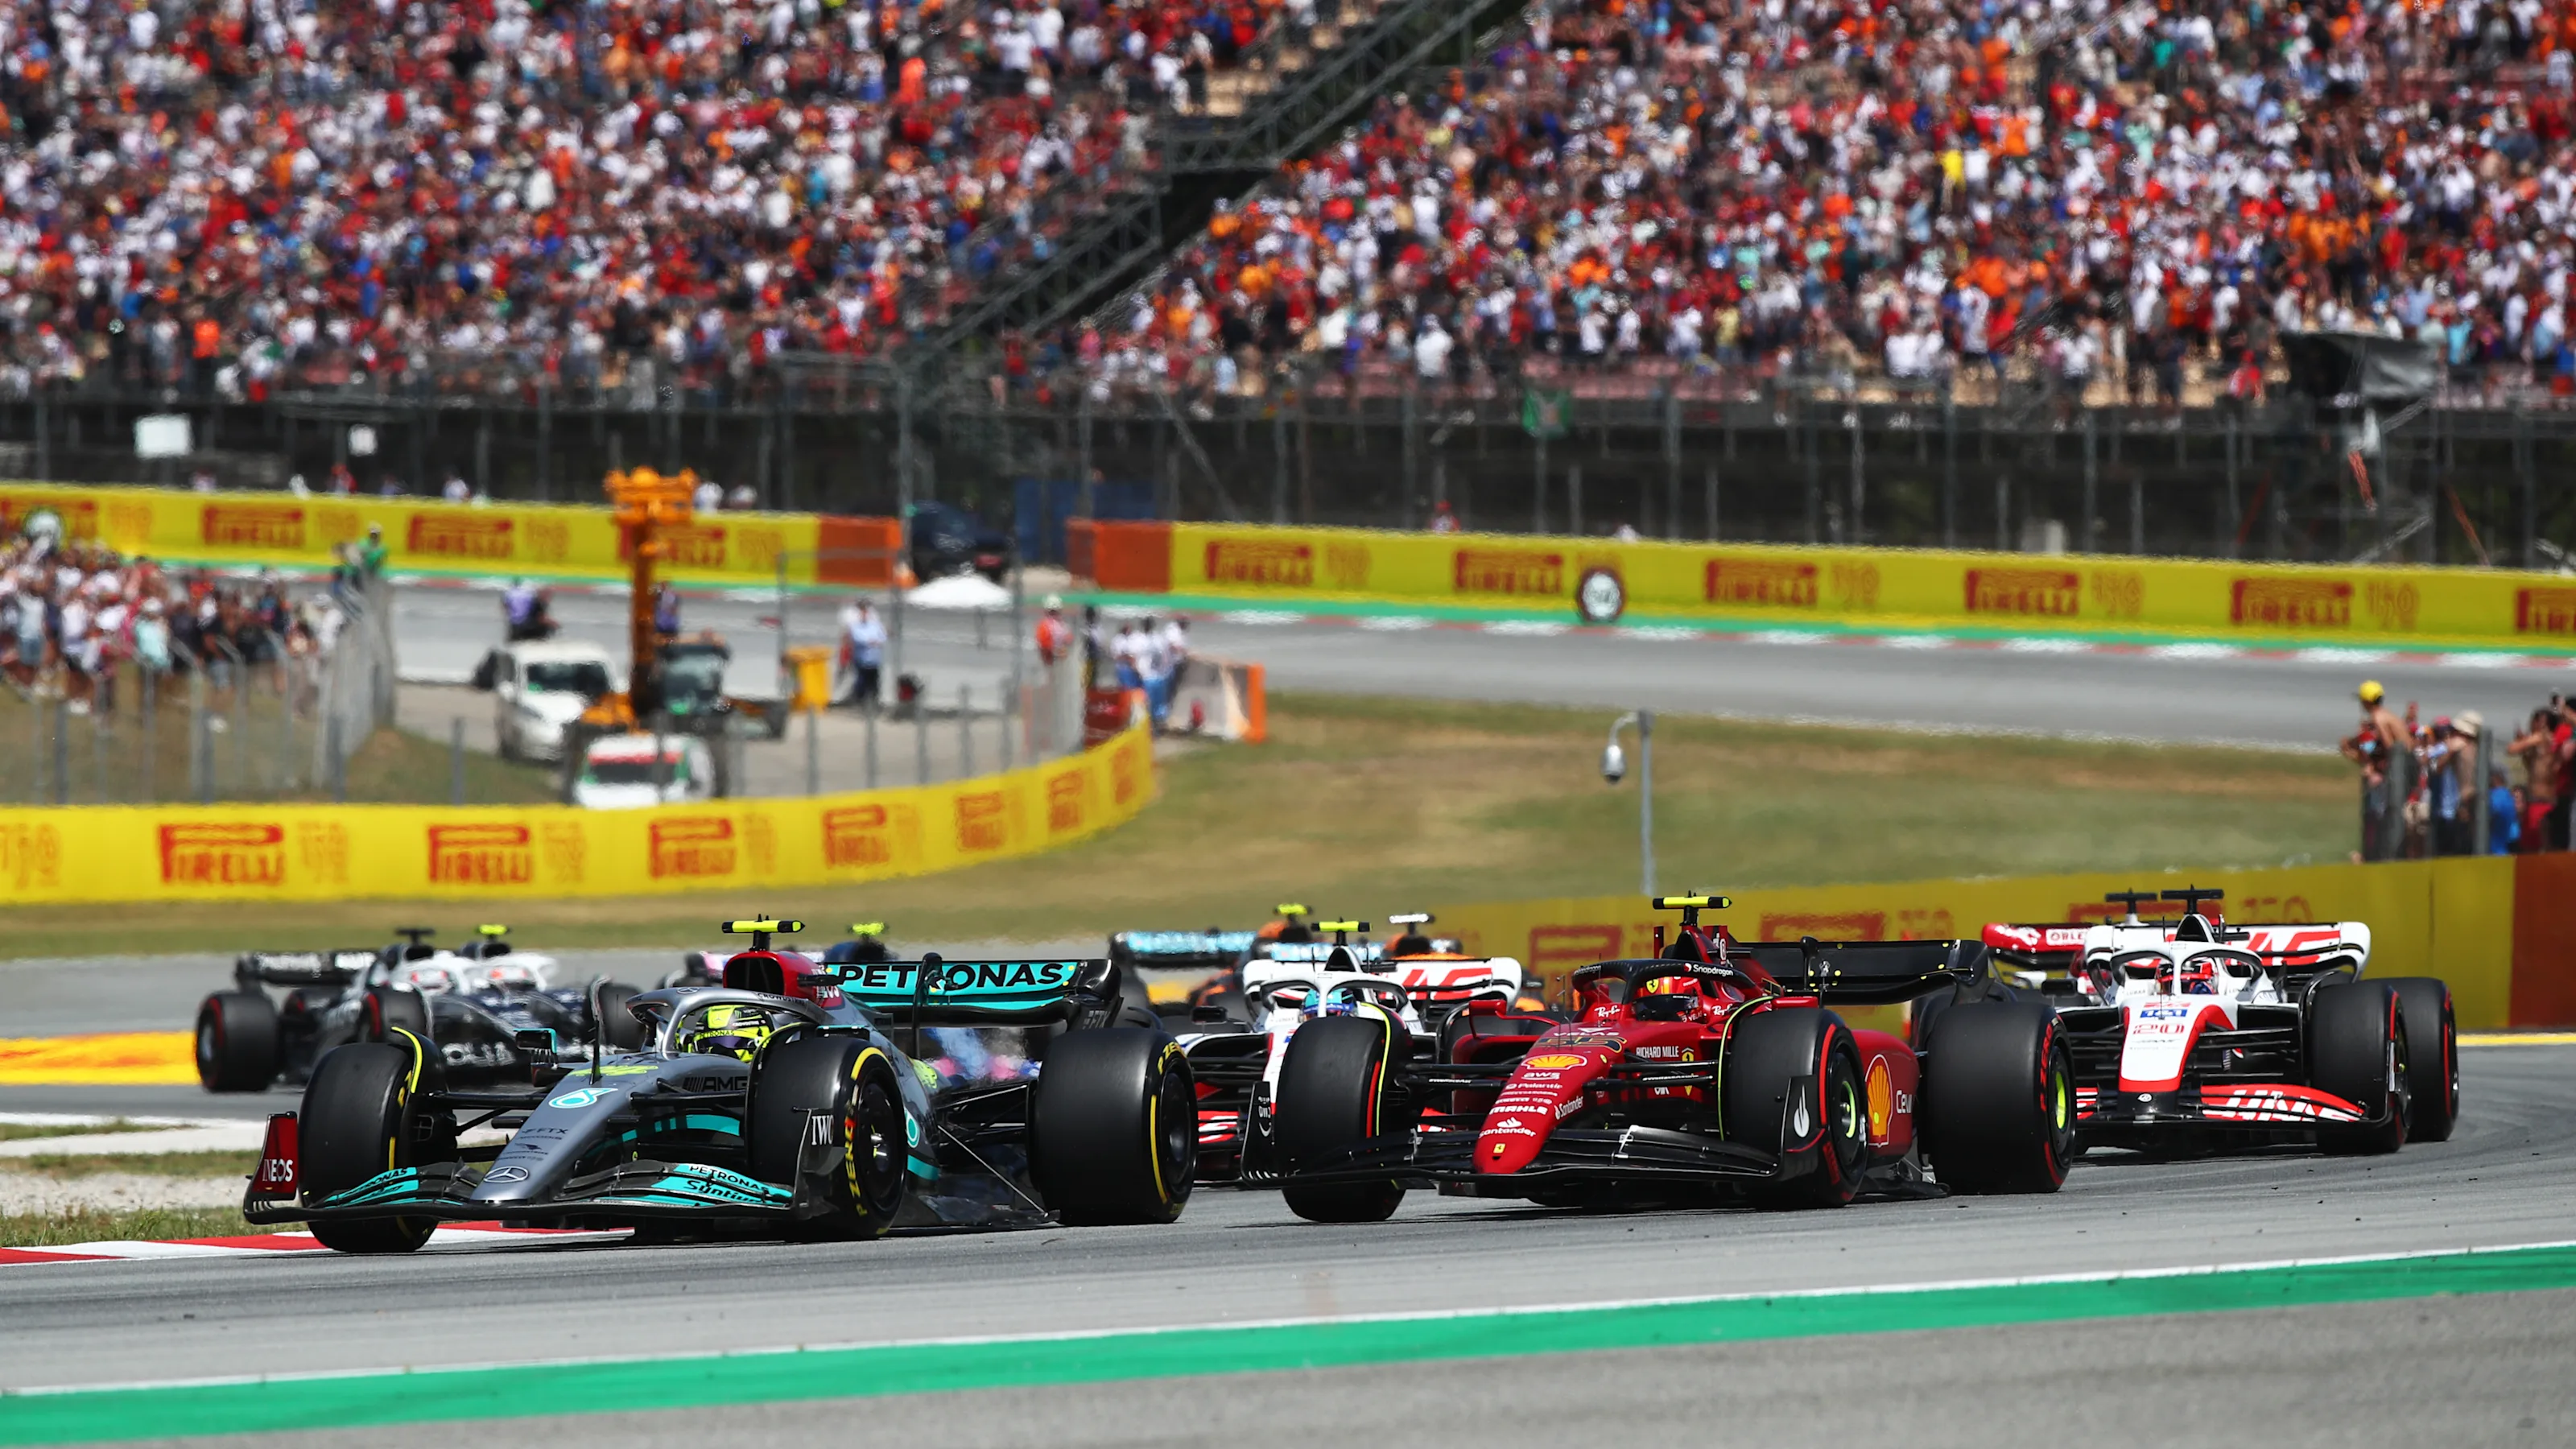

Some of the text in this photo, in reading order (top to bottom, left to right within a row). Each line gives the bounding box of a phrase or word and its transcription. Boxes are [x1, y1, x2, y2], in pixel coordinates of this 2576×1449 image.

[2050, 931, 2085, 941] ORLE
[1693, 964, 1734, 977] Snapdragon
[2133, 1024, 2185, 1034] 20
[1636, 1046, 1679, 1059] RICHARD MILLE
[1525, 1071, 1561, 1080] aws
[1489, 1105, 1548, 1115] MAHLE
[262, 1159, 293, 1182] INEOS
[690, 1166, 770, 1195] PETRONAS
